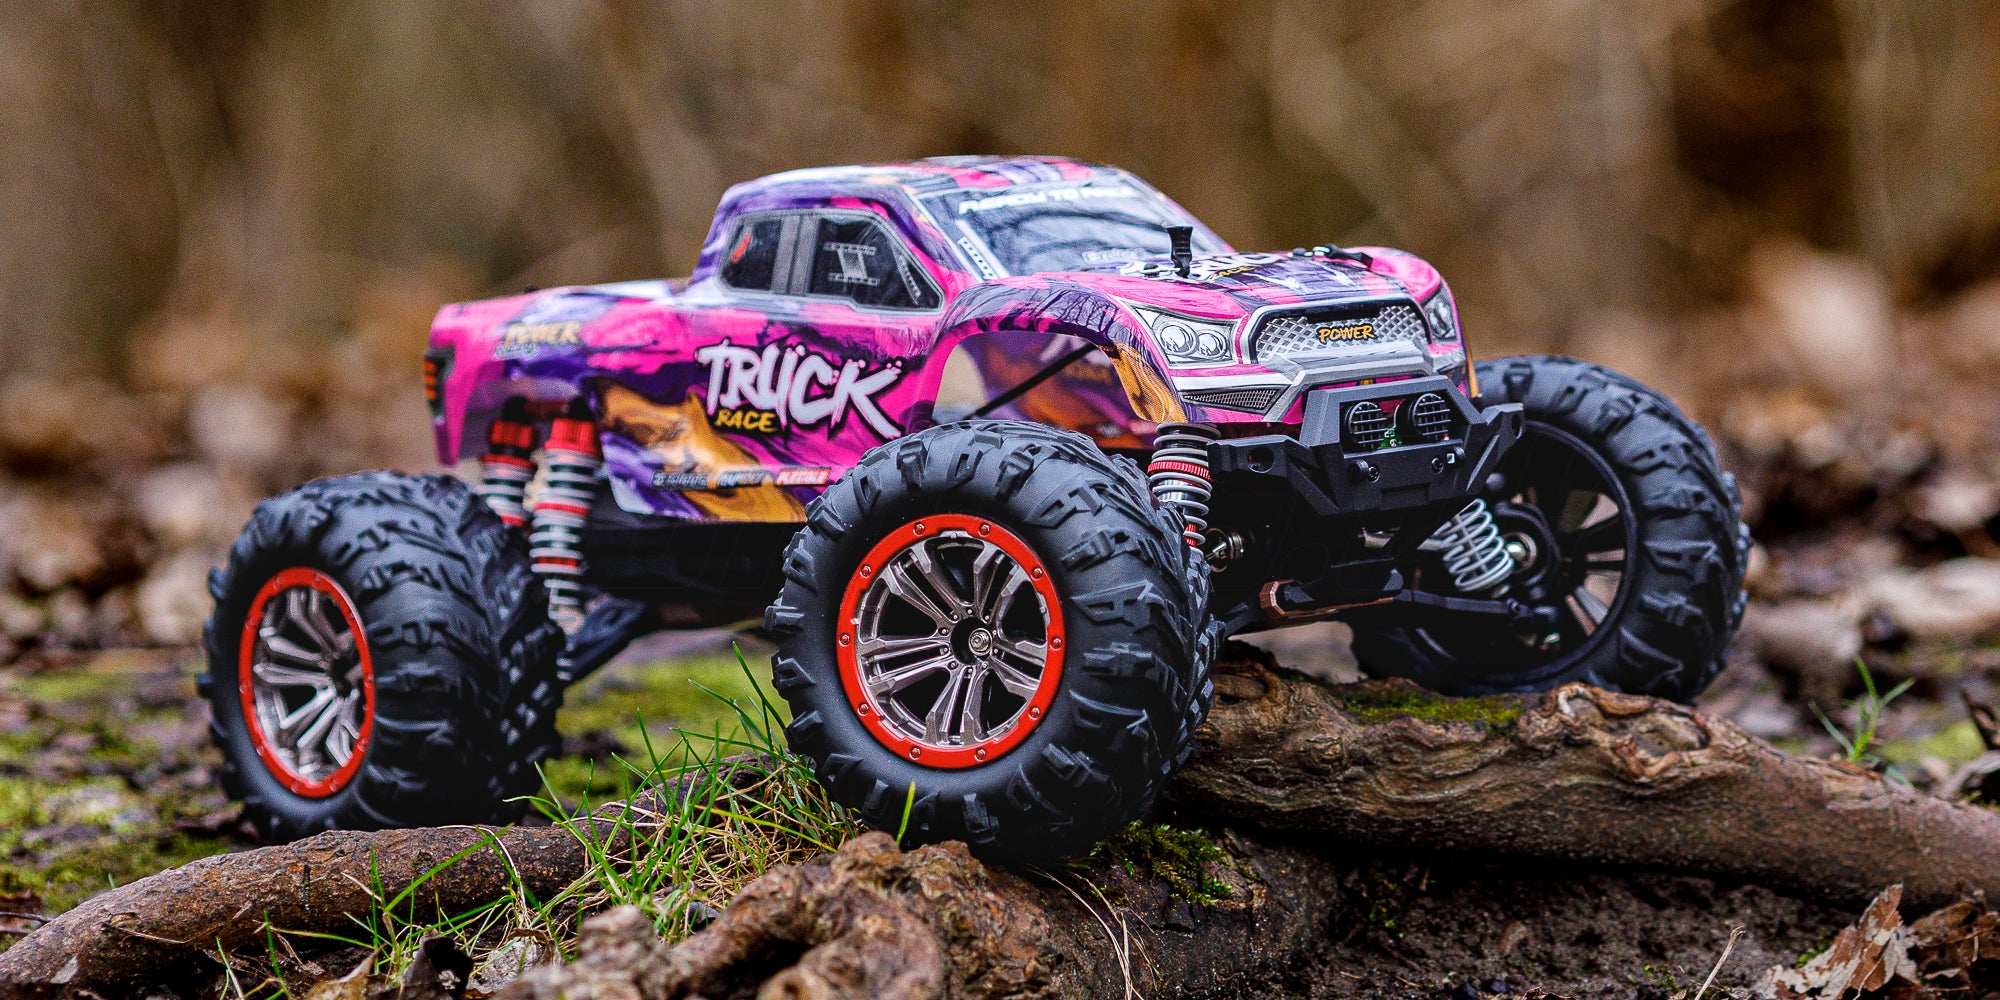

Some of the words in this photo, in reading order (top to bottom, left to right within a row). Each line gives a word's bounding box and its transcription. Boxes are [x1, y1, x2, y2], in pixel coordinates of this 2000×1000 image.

[505, 322, 580, 346] POWER
[1318, 325, 1374, 342] POWER
[694, 339, 901, 439] TRUCK
[715, 409, 778, 432] RACE
